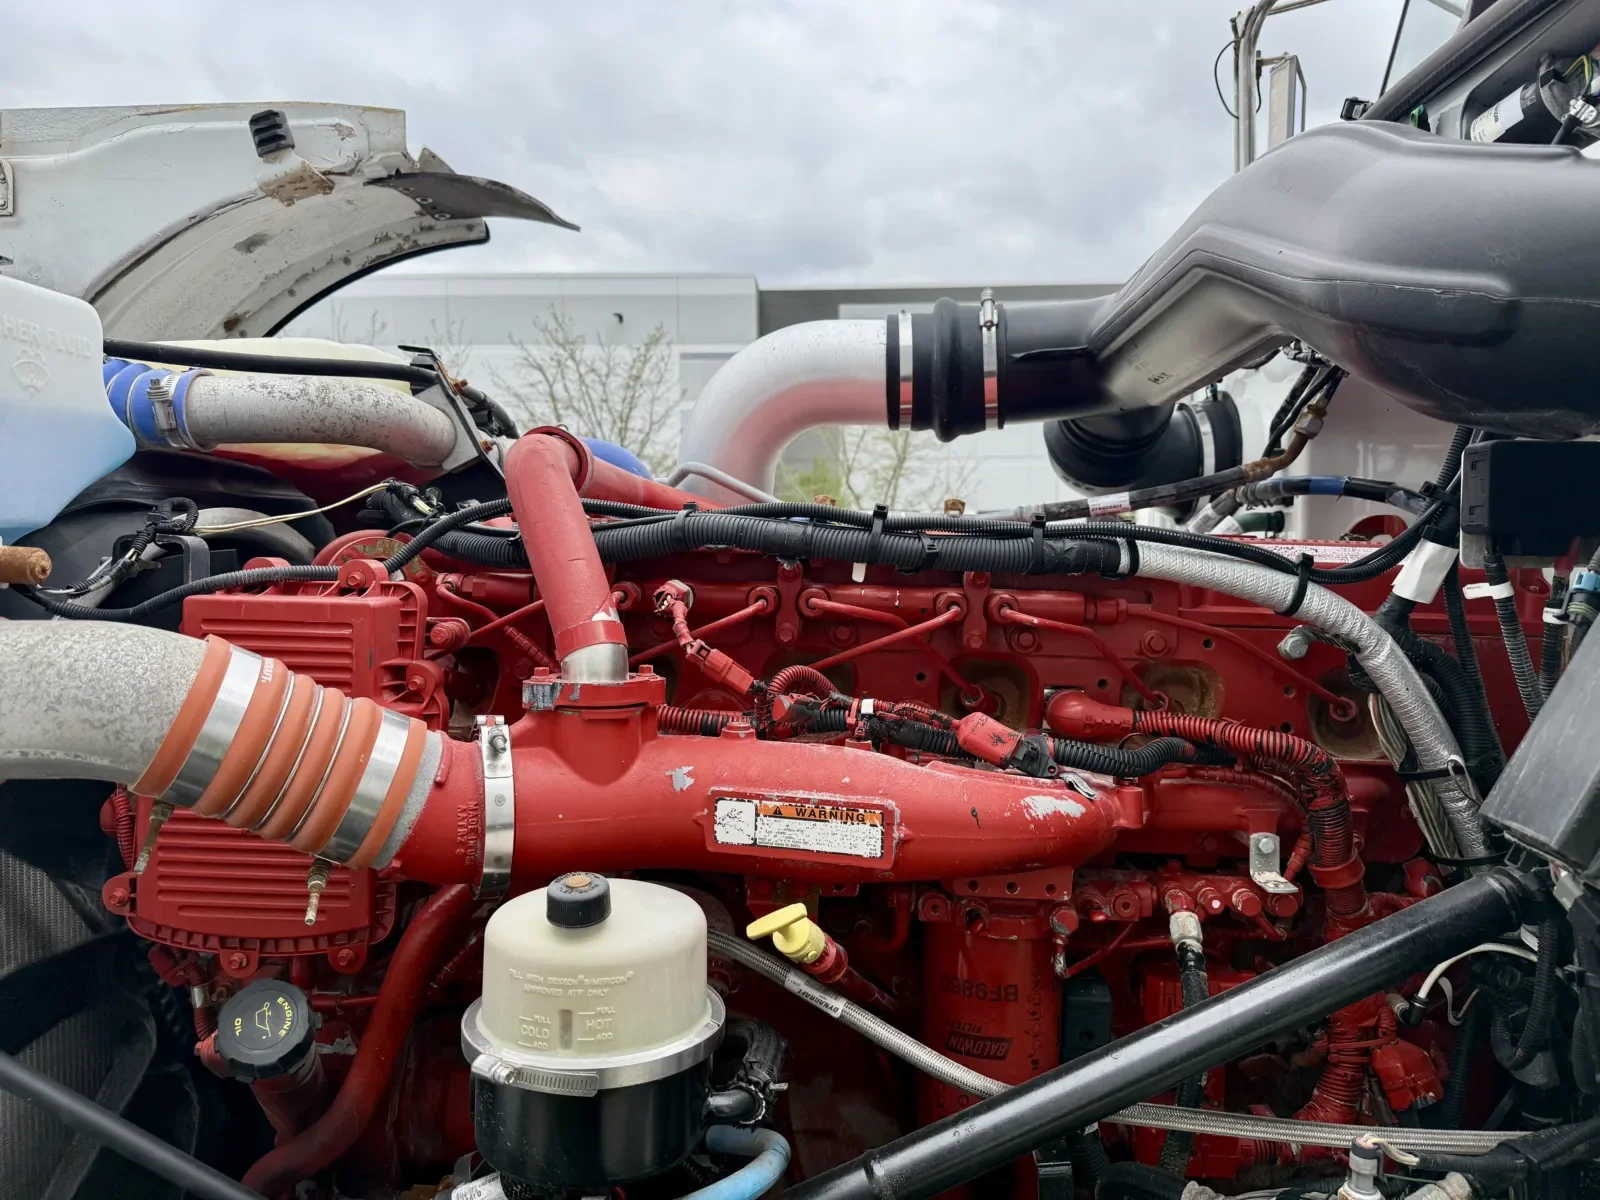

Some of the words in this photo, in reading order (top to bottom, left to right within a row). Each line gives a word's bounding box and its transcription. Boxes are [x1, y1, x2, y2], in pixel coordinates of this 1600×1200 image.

[45, 327, 93, 359] FLUID
[468, 801, 479, 833] MADE
[795, 807, 866, 823] WARNING
[467, 836, 478, 847] IN
[526, 972, 544, 983] WITH
[523, 983, 564, 996] APPROVED
[567, 988, 584, 997] ATF
[587, 988, 610, 997] ONLY
[276, 996, 293, 1037] ENGINE
[595, 1006, 617, 1015] FULL
[533, 1014, 553, 1024] FULL
[586, 1018, 613, 1030] HOT
[234, 1017, 243, 1037] OIL
[520, 1024, 550, 1039] COLD
[595, 1032, 613, 1041] ADD
[532, 1041, 549, 1050] ADD
[948, 1034, 1009, 1057] BALDWIN
